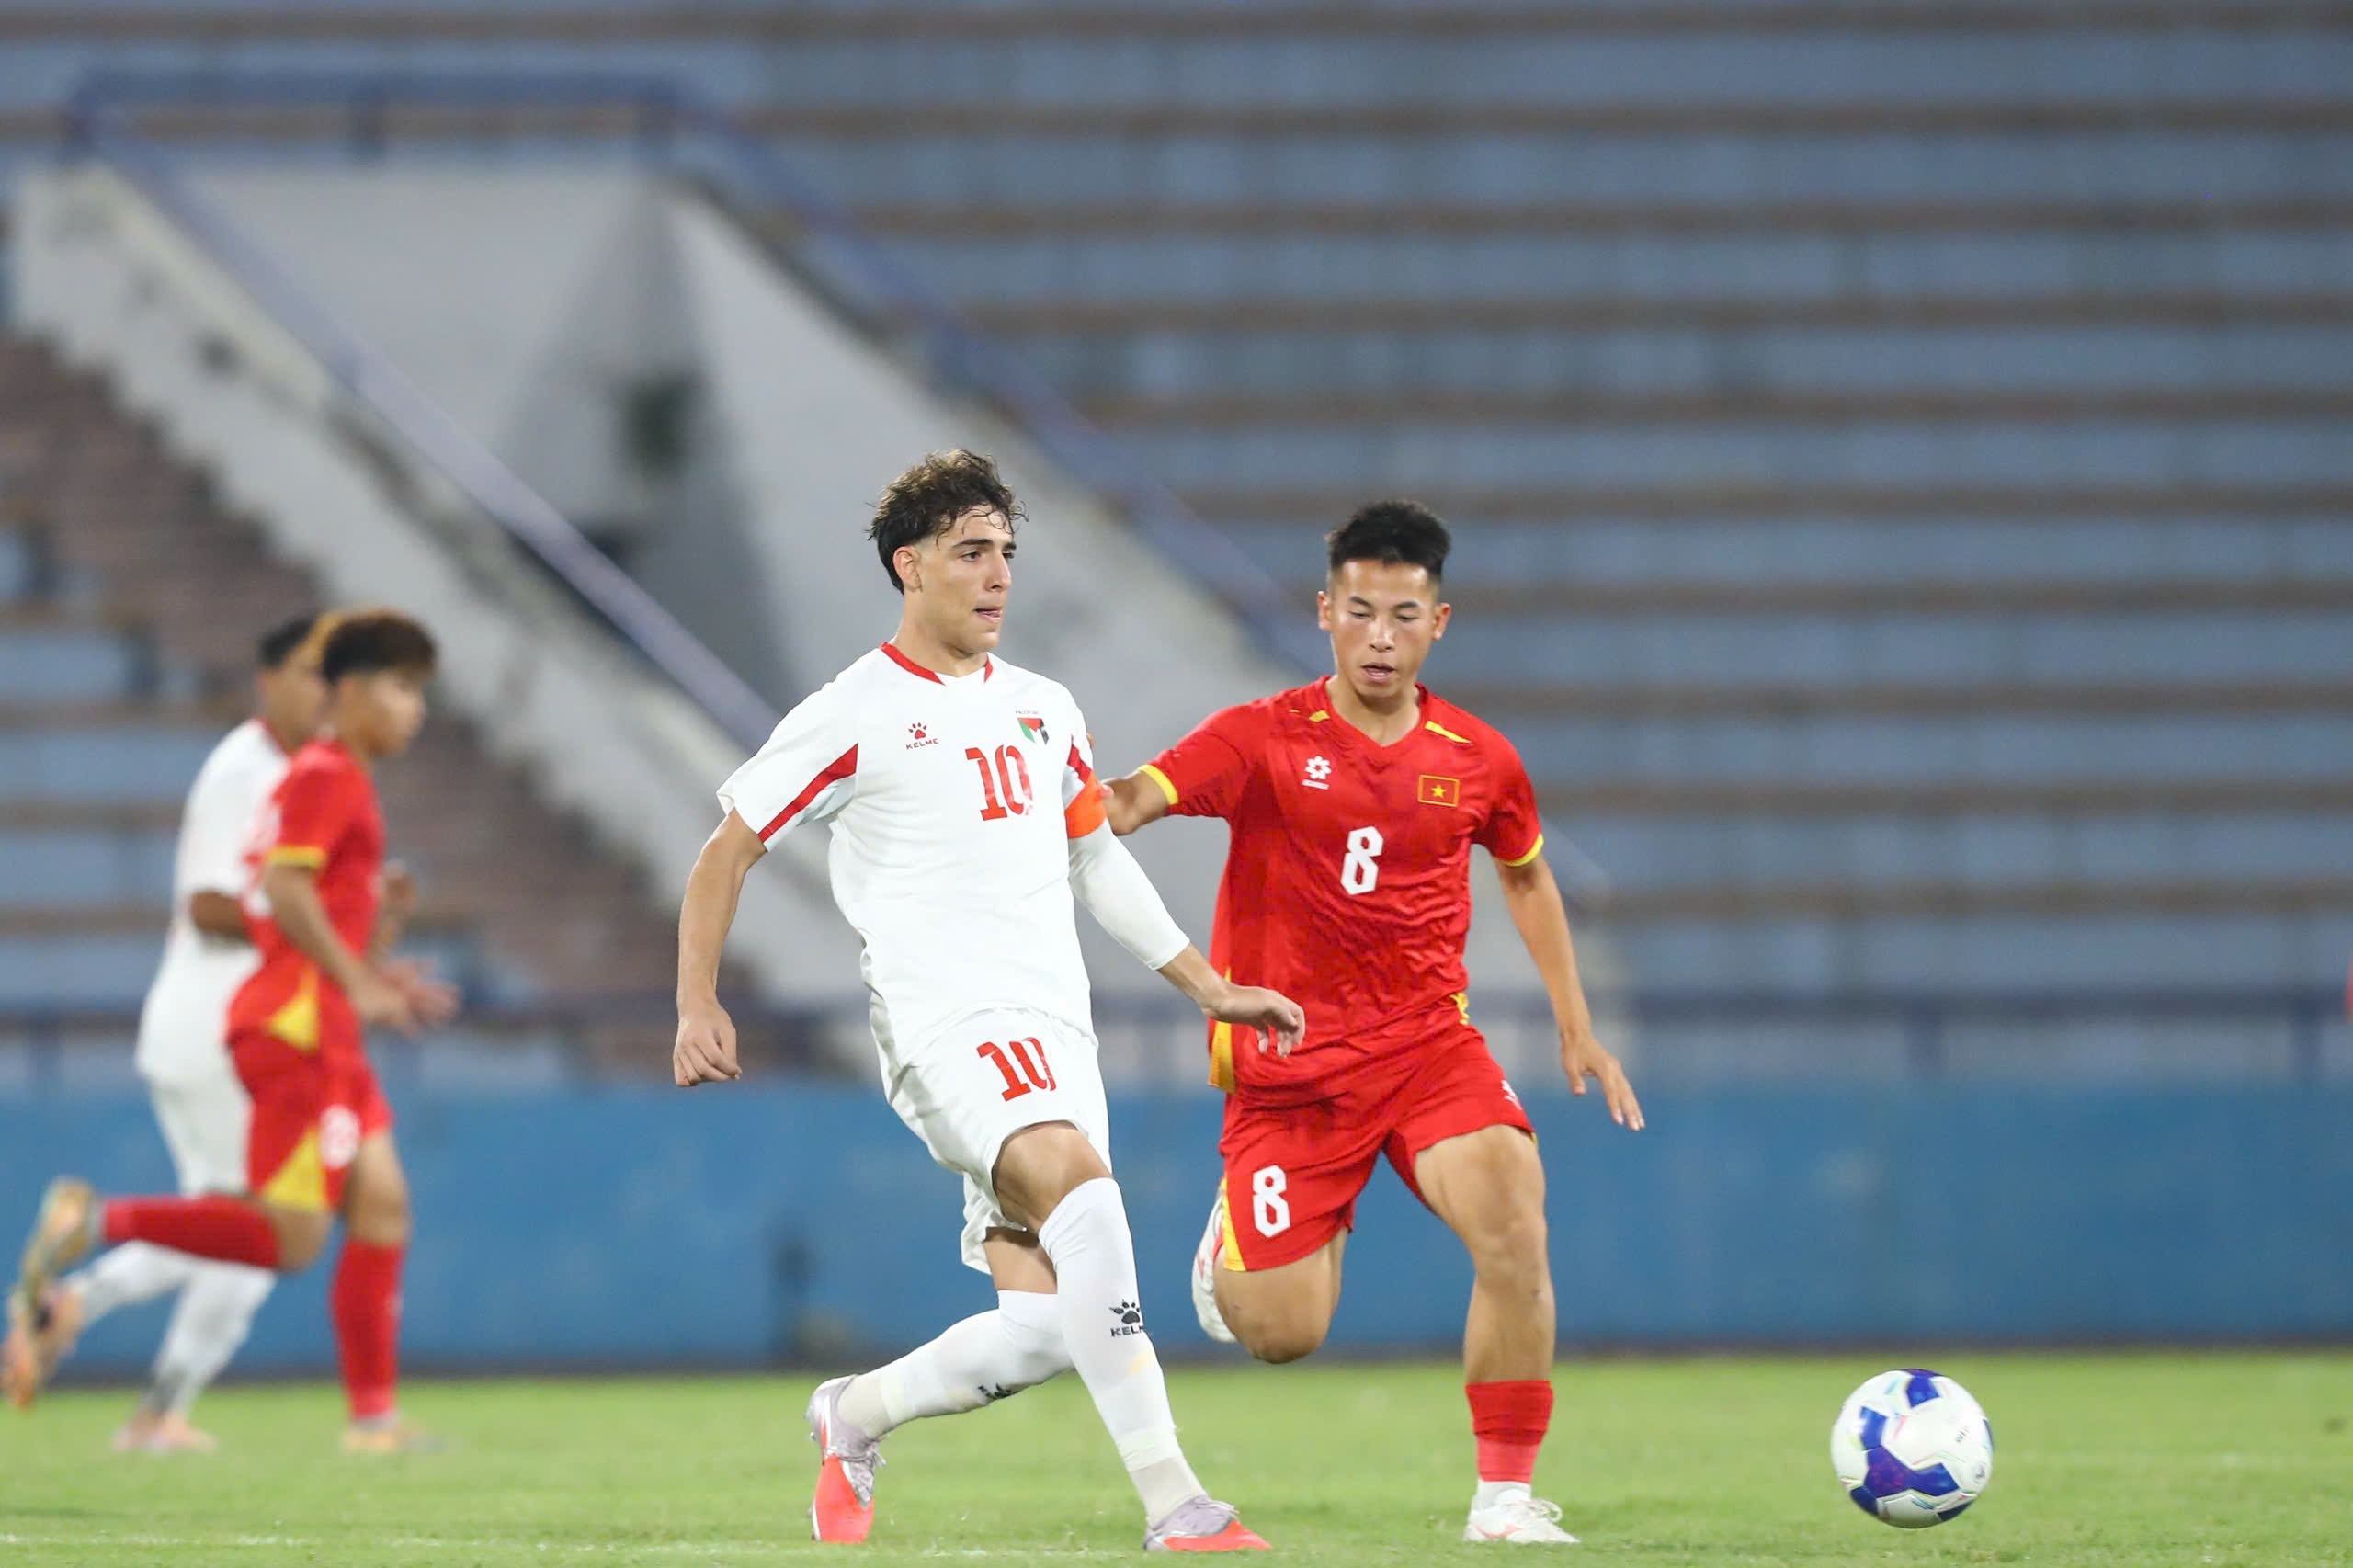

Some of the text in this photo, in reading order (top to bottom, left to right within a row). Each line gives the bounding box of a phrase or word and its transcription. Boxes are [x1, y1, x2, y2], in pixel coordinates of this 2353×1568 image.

[905, 738, 939, 750] KELME
[965, 744, 1033, 821] 10
[1340, 826, 1383, 895] 8
[976, 1037, 1056, 1101] 10
[1252, 1165, 1291, 1238] 8
